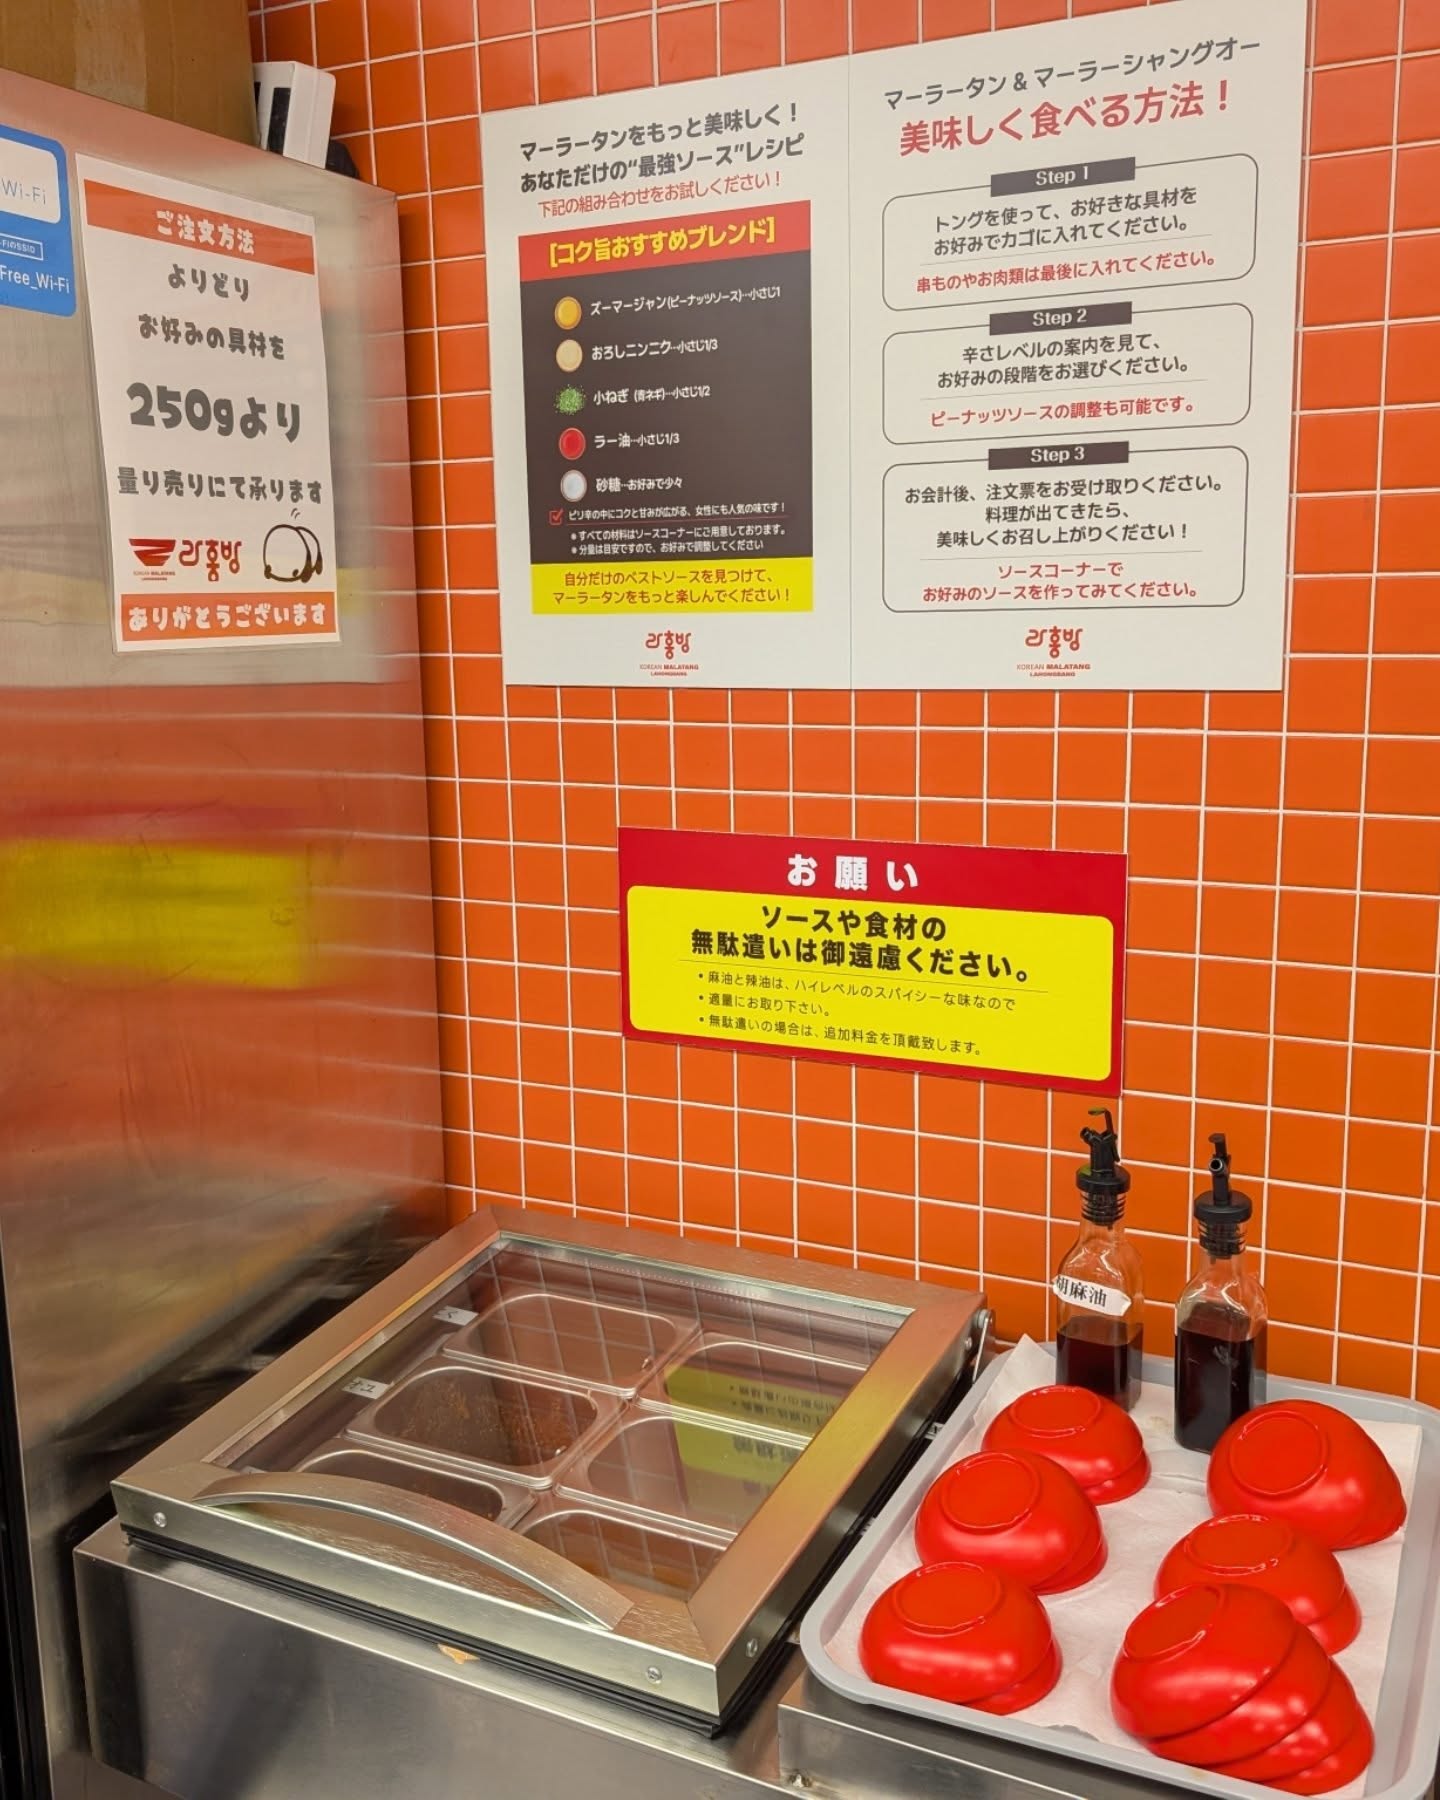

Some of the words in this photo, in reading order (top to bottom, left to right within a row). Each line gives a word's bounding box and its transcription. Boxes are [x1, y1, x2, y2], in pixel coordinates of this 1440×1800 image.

[884, 74, 1007, 111] マーラータン
[1013, 72, 1028, 92] &
[1034, 36, 1261, 89] マーラーシャングオー
[520, 102, 798, 162] マーラータンをもっと美味しく！
[900, 79, 1228, 157] 美味しく食べる方法！
[1, 178, 47, 205] Wi-Fi
[1035, 168, 1076, 187] Step
[1083, 166, 1090, 181] 1
[538, 171, 782, 218] 下記の組み合わせをお試しください！
[935, 187, 1198, 233] トングを使って、お好きな具材を
[154, 209, 255, 256] ご注文方法
[933, 215, 1188, 257] お好みでカゴに入れてください。
[167, 263, 250, 301] よりどり
[917, 249, 1216, 294] 串ものやお肉類は最後に入れてください。
[1033, 310, 1073, 327] Step
[1076, 308, 1087, 323] 2
[138, 313, 285, 361] お好みの具材を
[962, 332, 1161, 364] 辛さレベルの案内を見て、
[937, 356, 1188, 389] お好みの段階をお選びください。
[126, 382, 301, 444] 250gより
[594, 388, 630, 405] 小ねぎ
[931, 395, 1194, 428] ピーナッツソースの調整も可能です。
[1030, 448, 1070, 465] Step
[1074, 446, 1085, 461] 3
[117, 467, 323, 504] 量り売りにて承ります
[905, 475, 1222, 505] お会計後、注文票をお受け取りください。
[985, 501, 1130, 524] 料理が出てきたら、
[936, 524, 1188, 549] 美味しくお召し上がりください！
[565, 568, 774, 587] 自分だけのベストソースを見つけて、
[998, 562, 1124, 579] ソースコーナーで
[553, 589, 790, 605] マーラータンをもっと楽しんでください！
[922, 582, 1197, 603] お好みのソースを作ってみてください。
[127, 602, 326, 633] ありがとうございます
[761, 904, 946, 942] ソースや食材の
[691, 928, 1030, 983] 無駄遣いは御遠慮ください。
[708, 971, 1016, 1012] 麻油と辣油は、ハイレベルのスパイシーな味なので
[708, 993, 831, 1017] 適量にお取り下さい。
